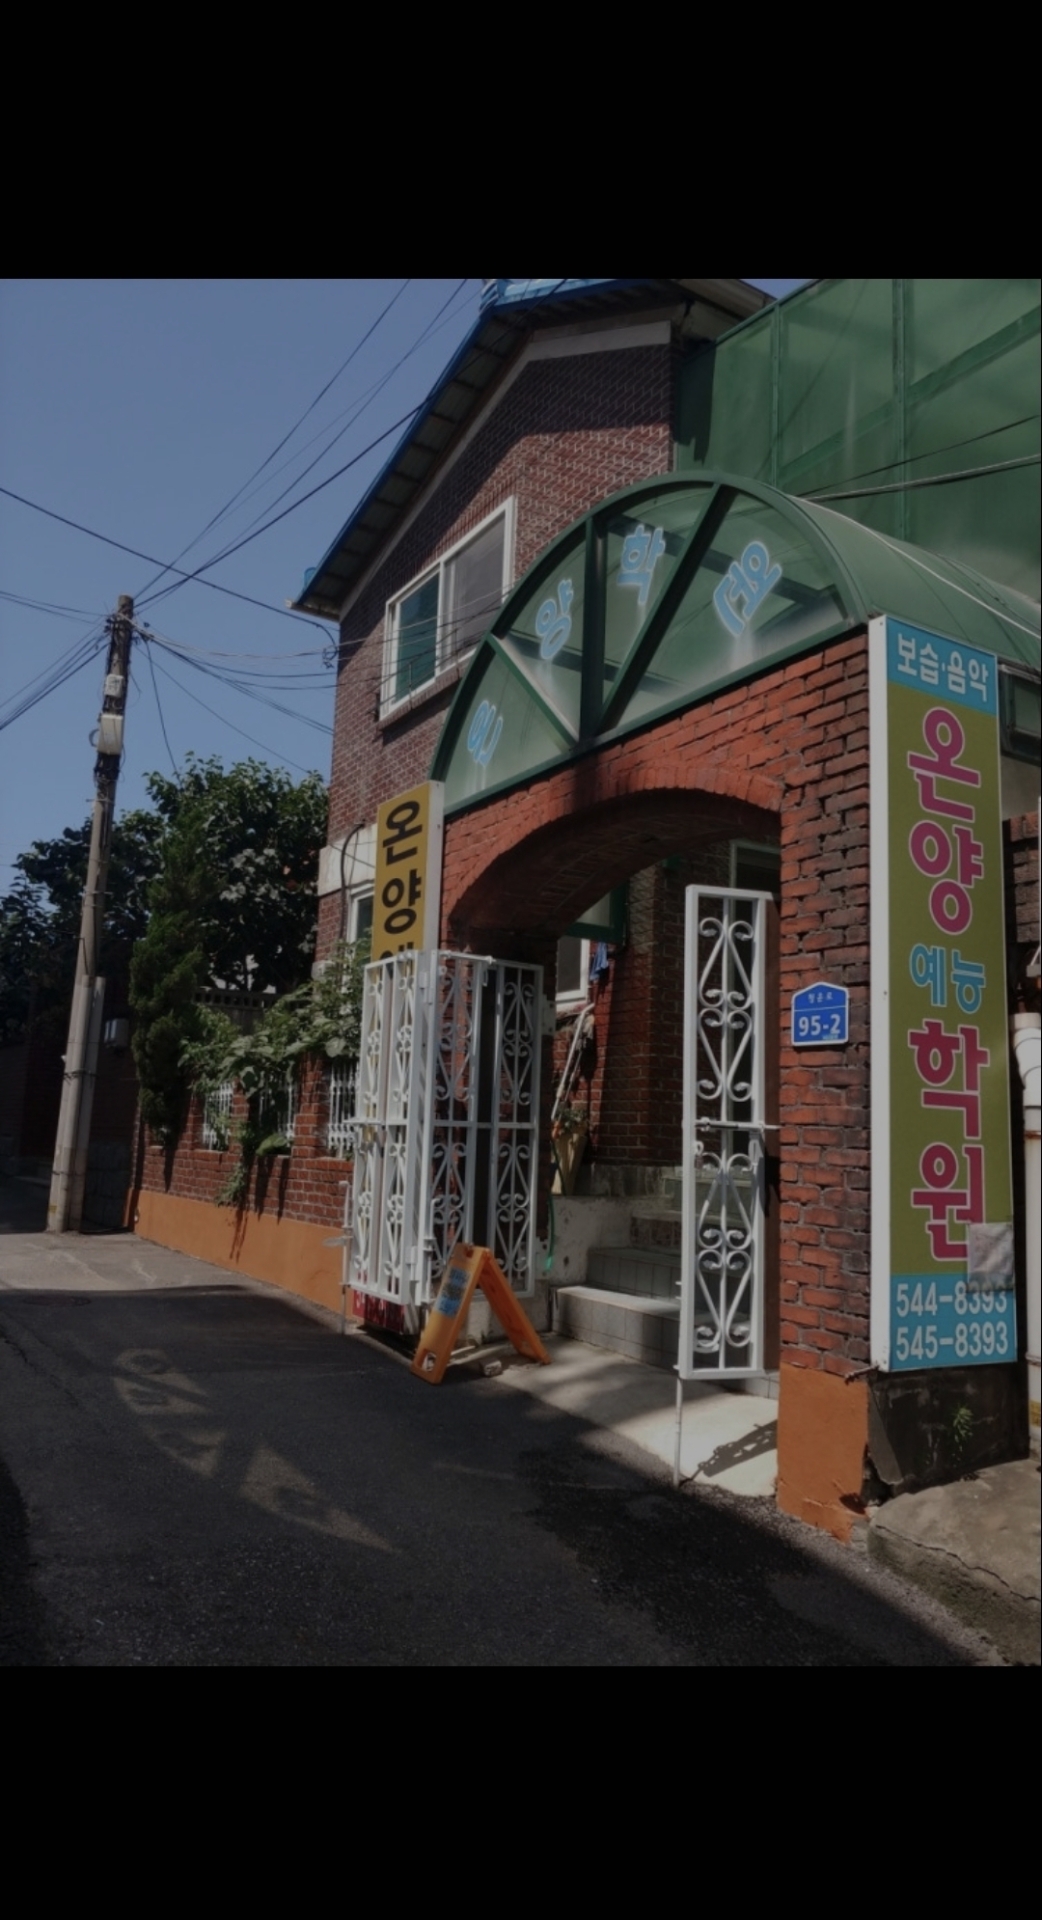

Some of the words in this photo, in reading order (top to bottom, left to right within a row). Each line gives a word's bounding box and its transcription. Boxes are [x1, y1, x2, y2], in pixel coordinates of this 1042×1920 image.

[909, 943, 986, 1015] 예능
[798, 1013, 841, 1037] 95-2
[896, 1280, 1008, 1318] 544-8393
[896, 1320, 1009, 1361] 545-8393
